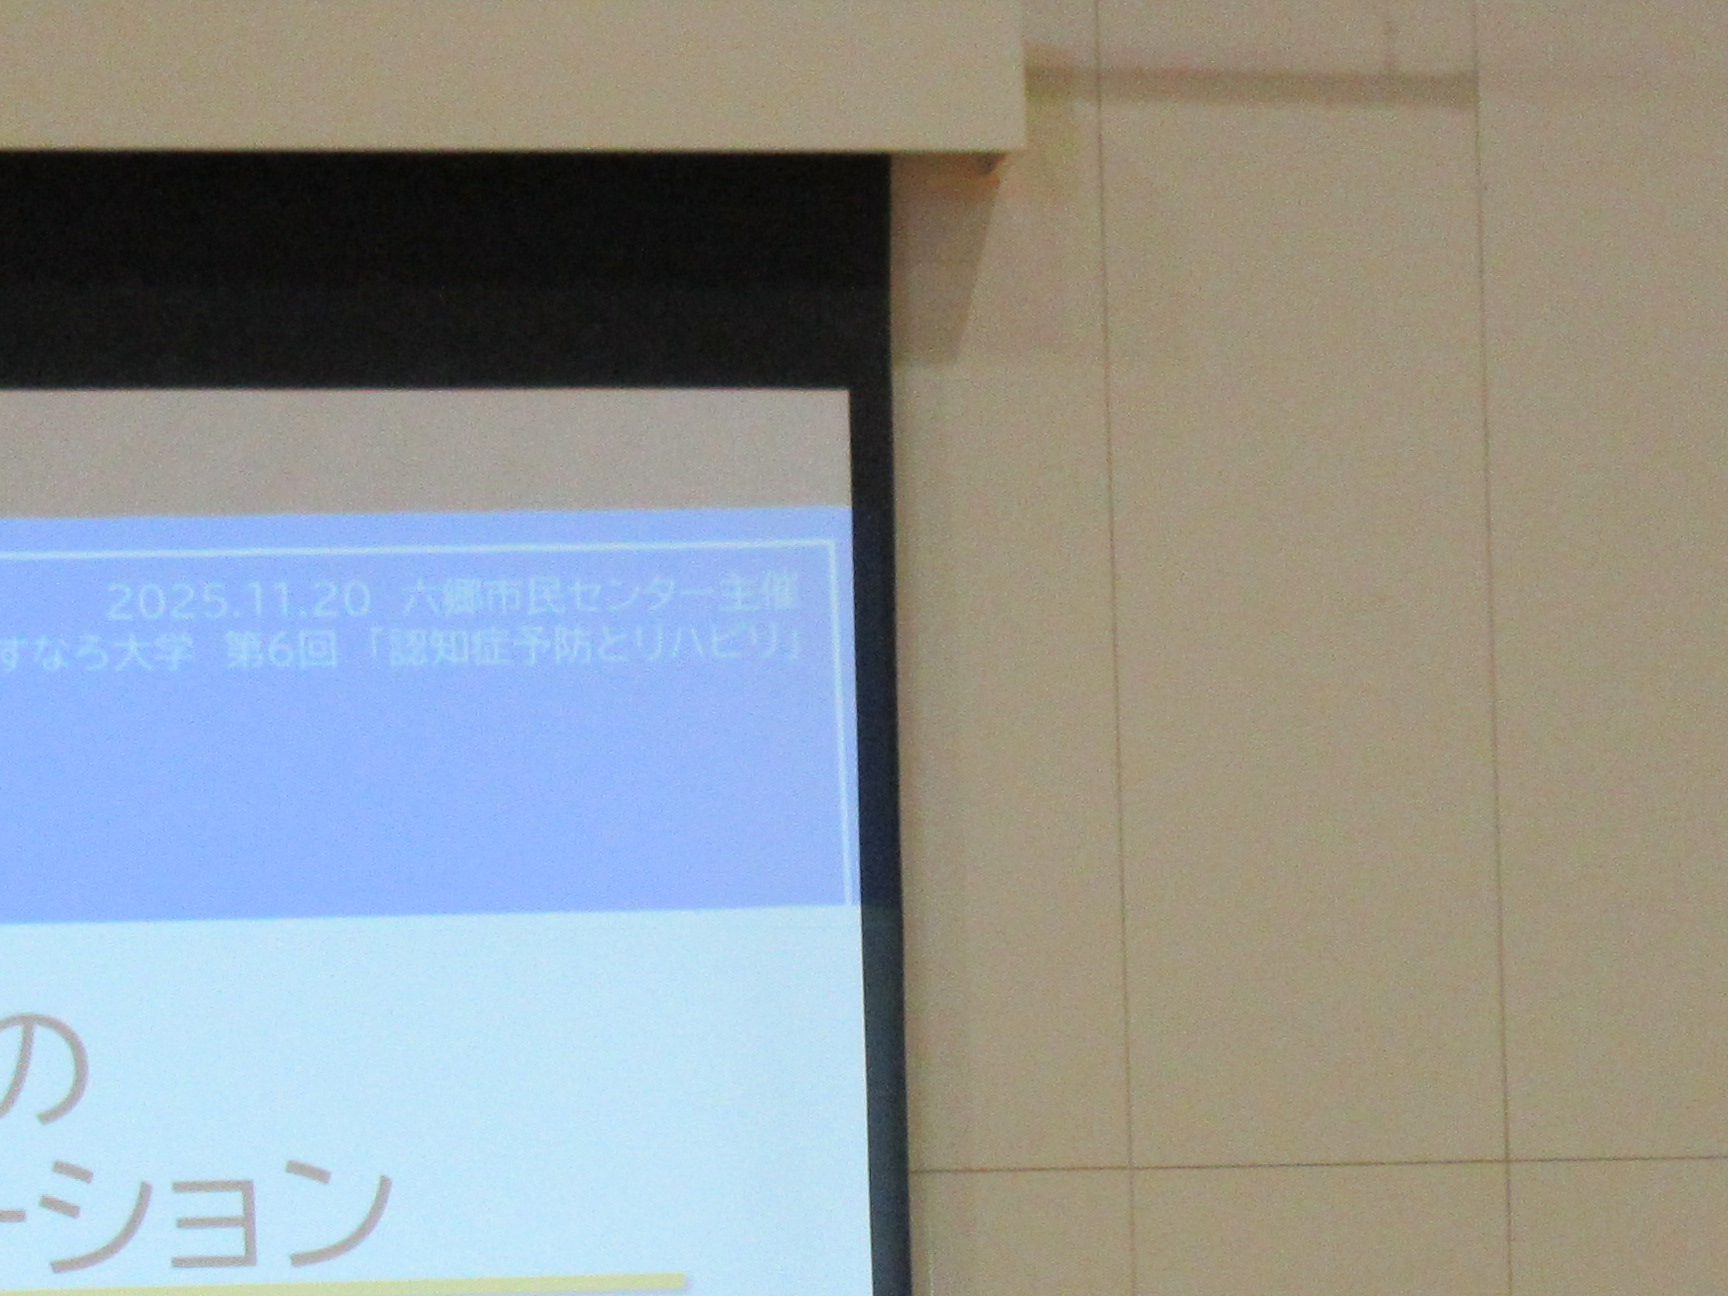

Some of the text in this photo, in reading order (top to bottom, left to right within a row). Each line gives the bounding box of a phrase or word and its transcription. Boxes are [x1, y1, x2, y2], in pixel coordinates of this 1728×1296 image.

[105, 570, 801, 621] 2025.11.20 六郷市民センター主催
